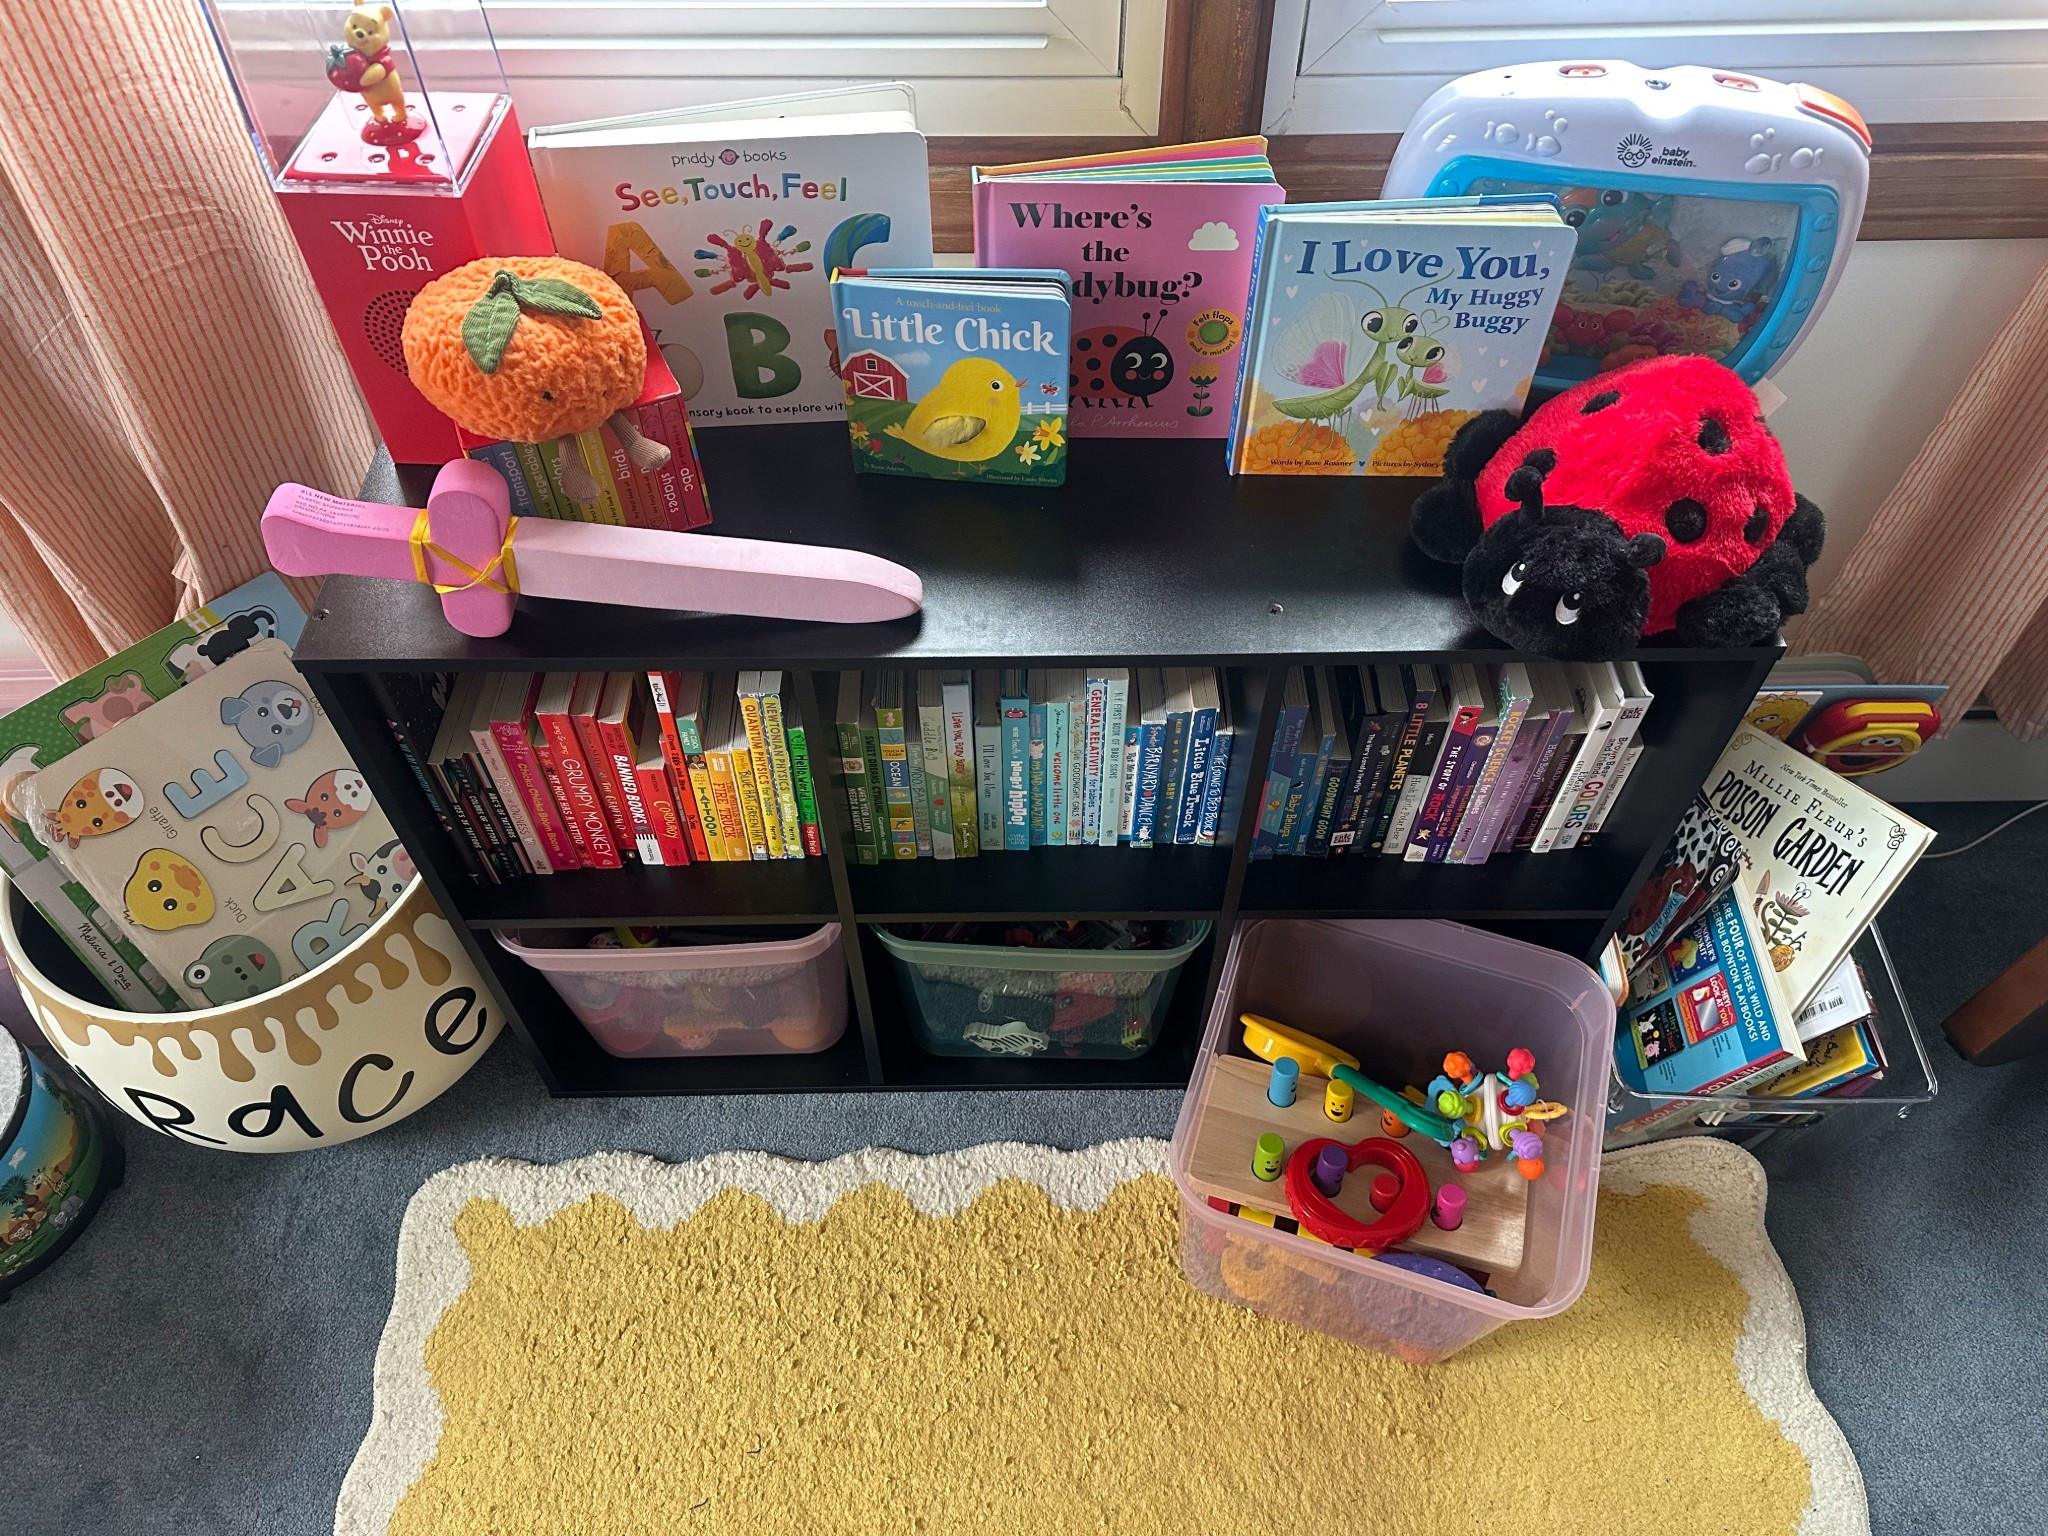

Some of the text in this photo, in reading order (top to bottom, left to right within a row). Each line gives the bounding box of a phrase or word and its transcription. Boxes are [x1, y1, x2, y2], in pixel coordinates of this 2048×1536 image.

[671, 149, 787, 168] priddy books
[1661, 146, 1690, 159] baby
[614, 172, 848, 212] See, Touch, Feel
[367, 213, 404, 226] Disney
[1008, 202, 1152, 229] Where's
[330, 220, 434, 247] Winnie
[357, 247, 434, 273] Pooh
[383, 244, 403, 255] the
[1081, 240, 1130, 262] the
[1296, 240, 1551, 281] I Love You,
[1072, 271, 1202, 305] dybug?
[1425, 286, 1545, 310] My Huggy
[842, 307, 1061, 356] Little Chick
[1192, 310, 1234, 327] Felt flaps
[1453, 312, 1530, 334] Buggy
[1189, 340, 1201, 352] and
[1209, 340, 1236, 357] mirror!
[688, 407, 723, 420] nsory
[725, 402, 754, 416] book
[757, 404, 772, 415] to
[775, 402, 822, 416] explore
[500, 450, 529, 507] transport
[523, 441, 550, 499] vegetables
[313, 493, 331, 502] NEW
[331, 497, 365, 511] MATERIAL
[661, 472, 679, 513] shapes
[1089, 688, 1102, 729] GENERAL
[1414, 701, 1428, 709] 8
[921, 716, 938, 761] Cuddle Bug
[1403, 713, 1424, 745] LITTLE
[1497, 710, 1523, 745] ROCKET
[1087, 731, 1100, 776] RELATIVITY
[1448, 745, 1462, 757] THE
[1481, 746, 1507, 783] SCIENCE
[1541, 742, 1557, 762] Hello
[1588, 738, 1617, 779] and Friends
[1598, 734, 1629, 778] Brown Bear
[743, 704, 778, 839] QUANTUM PHYSICS for babies Ferrie
[765, 701, 796, 840] NEWTONIAN PHYSICS for babies Ferrie
[864, 735, 884, 813] SWEET DREAMS CTHULHU
[889, 761, 901, 786] OCEAN
[1009, 760, 1023, 789] hungry
[1126, 764, 1134, 772] Me
[1182, 737, 1209, 828] Little Blue Truck
[1388, 748, 1413, 790] PLANETS
[1440, 761, 1456, 780] STORY
[1531, 762, 1548, 779] Baby!
[612, 753, 638, 794] BANNED
[625, 794, 647, 824] BOOKS
[712, 782, 729, 804] FIRE
[1088, 779, 1097, 787] for
[1124, 781, 1132, 791] the
[1406, 776, 1421, 793] Hush
[1479, 783, 1491, 792] for
[1779, 761, 1795, 775] New
[1804, 776, 1823, 792] Times
[1820, 786, 1850, 809] Bestseller
[515, 763, 563, 851] Chicka Chicka Boom Boom
[560, 758, 613, 857] GRUMPY MONKEY
[696, 786, 719, 836] TATTOOS
[856, 786, 871, 832] WHEN YOUR LLAMA
[1007, 790, 1027, 825] hippo!
[1088, 788, 1096, 808] babies
[1123, 792, 1132, 804] Zoo
[1284, 793, 1302, 813] Baby
[1313, 777, 1340, 839] GOODNIGHT GOON
[1423, 793, 1445, 821] ROCK
[1446, 783, 1474, 836] Five Little Monkeys
[1469, 794, 1487, 815] babies
[1562, 778, 1606, 830] COLORS
[1742, 758, 1871, 849] MILLIE FLEUR'S
[146, 805, 179, 841] Giraffe
[653, 800, 678, 838] CORDUROY
[718, 808, 736, 837] TRUCK
[1277, 812, 1297, 837] Beluga
[1375, 819, 1388, 836] DOYLE
[1395, 812, 1409, 826] Polar
[1711, 769, 1865, 897] POISON GARDEN
[1459, 826, 1472, 842] Ferrie
[222, 896, 247, 924] Duck
[1693, 927, 1707, 957] BINKIT
[1697, 916, 1718, 962] DINOSAUR'S
[74, 921, 112, 963] Melissa
[108, 964, 134, 991] Doug
[1721, 901, 1771, 1041] ARE FOUR OF THESE WILD AND
[1708, 976, 1731, 1028] LOOK AT YOU!
[1719, 938, 1741, 983] BOYNTON
[1733, 983, 1758, 1042] PLAYBOOKS!
[1720, 988, 1730, 1008] HEY!
[1726, 1063, 1761, 1084] HEY!
[1640, 1107, 1669, 1125] YOU!
[1672, 1098, 1690, 1111] AT
